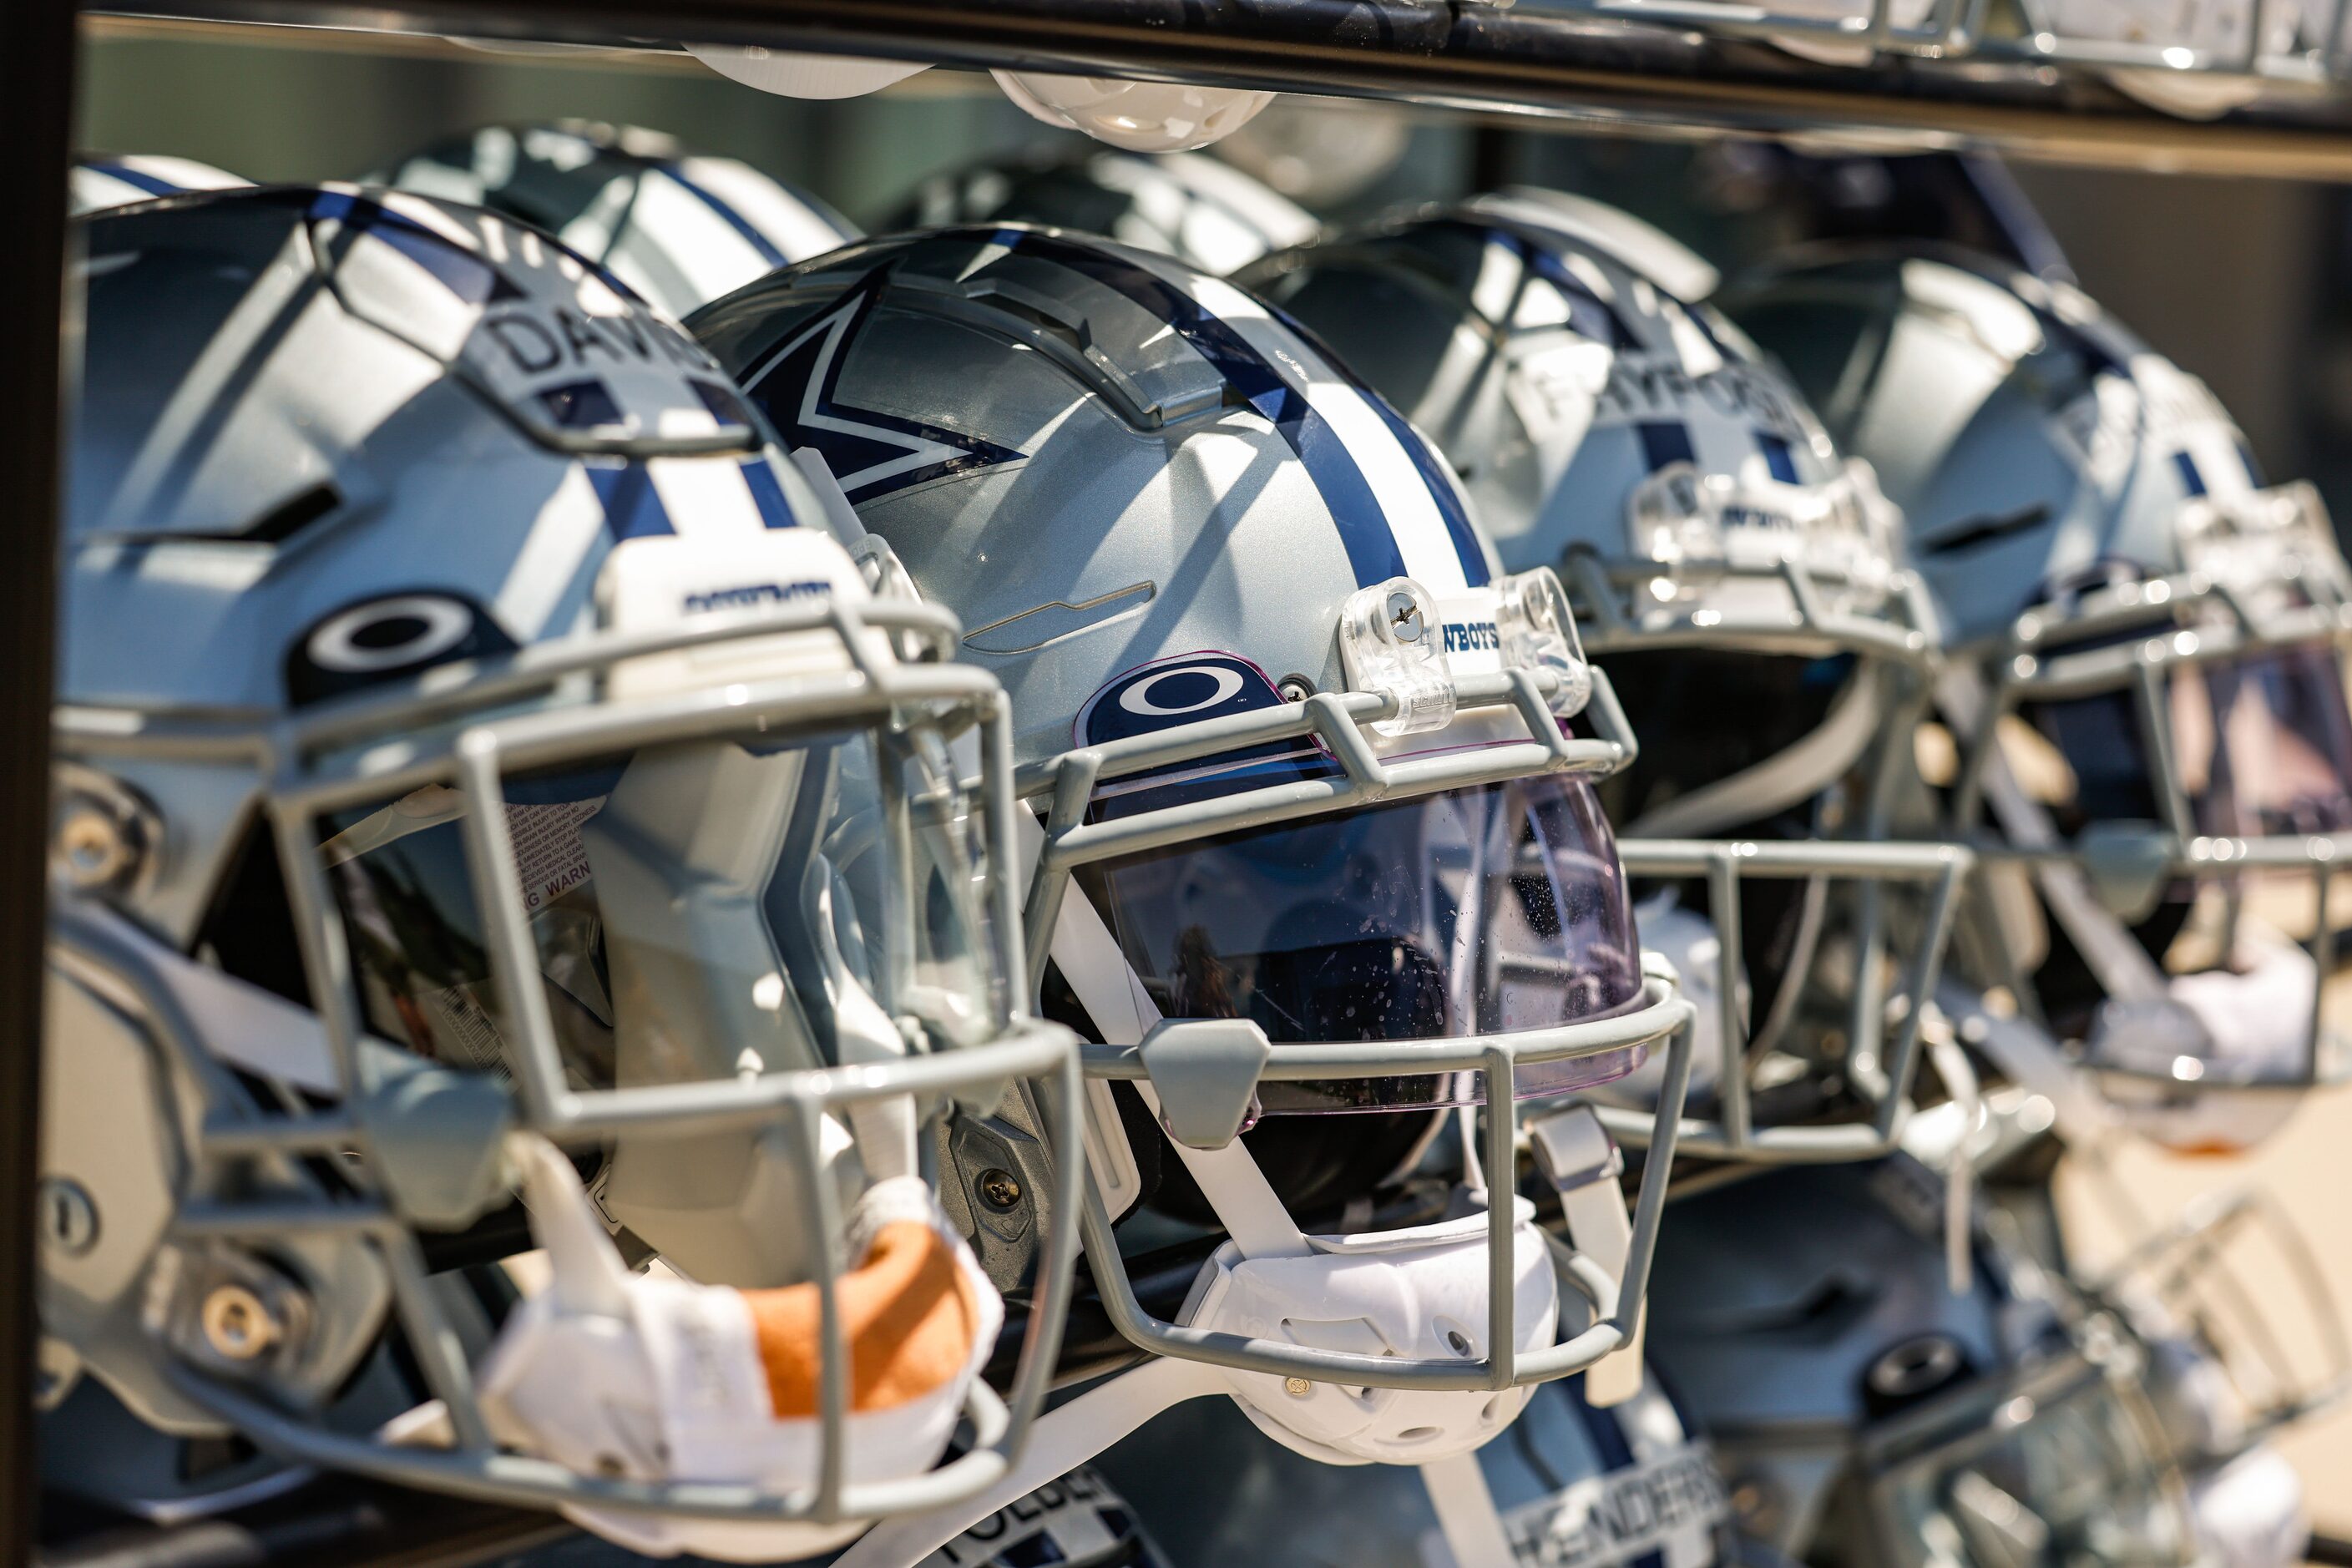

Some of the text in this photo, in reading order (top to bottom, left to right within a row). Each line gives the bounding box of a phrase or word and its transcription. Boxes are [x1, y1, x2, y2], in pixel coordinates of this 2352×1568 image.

[1441, 621, 1500, 653] WBOYS
[513, 810, 524, 818] RAM
[518, 817, 528, 825] USE
[529, 810, 539, 818] CAN
[532, 815, 548, 827] INJURY
[538, 821, 554, 833] INJURY
[554, 811, 570, 822] WHICH
[524, 842, 554, 862] IMMEDIATELY
[555, 833, 567, 843] STOP
[568, 825, 580, 836] PLAY
[521, 864, 532, 873] NOT
[532, 852, 551, 867] RETURN
[564, 837, 577, 847] GAME
[545, 854, 565, 869] MEDICAL
[528, 874, 549, 889] SERIOUS
[558, 860, 571, 872] FATAL
